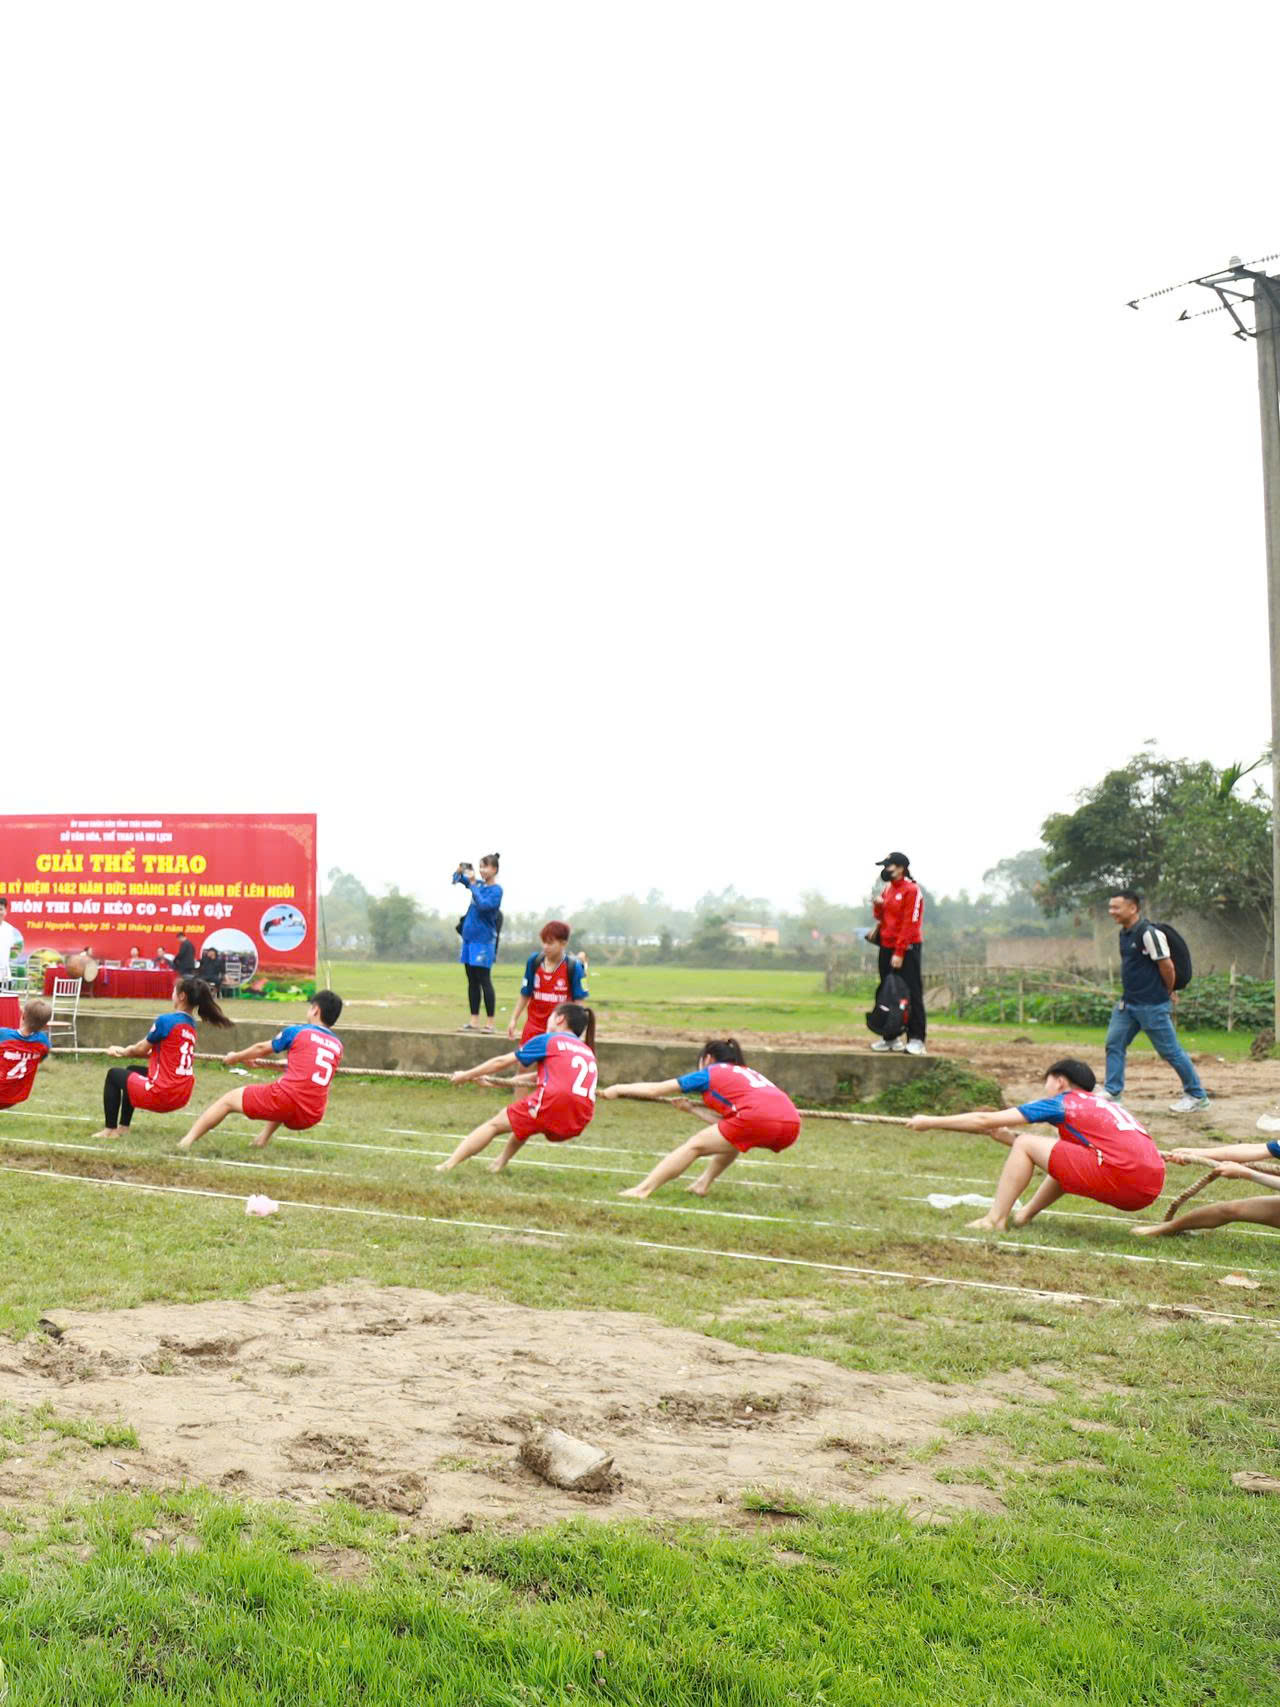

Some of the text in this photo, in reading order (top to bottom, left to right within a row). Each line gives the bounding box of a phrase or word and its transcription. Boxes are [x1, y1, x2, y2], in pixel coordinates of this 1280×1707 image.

[36, 848, 83, 873] GIẢI
[142, 854, 207, 874] THAO
[52, 881, 77, 894] 1482
[128, 881, 164, 896] HOÀNG
[183, 882, 196, 896] LÝ
[198, 883, 225, 897] NAM
[243, 883, 265, 898] LÊN
[267, 883, 295, 898] NGÔI
[10, 899, 43, 913] MÔN
[45, 901, 70, 914] THI
[72, 899, 100, 914] ĐẤU
[103, 901, 133, 915] KÉO
[136, 903, 157, 916] CO
[203, 902, 233, 920] GẬY
[311, 1046, 336, 1087] 5
